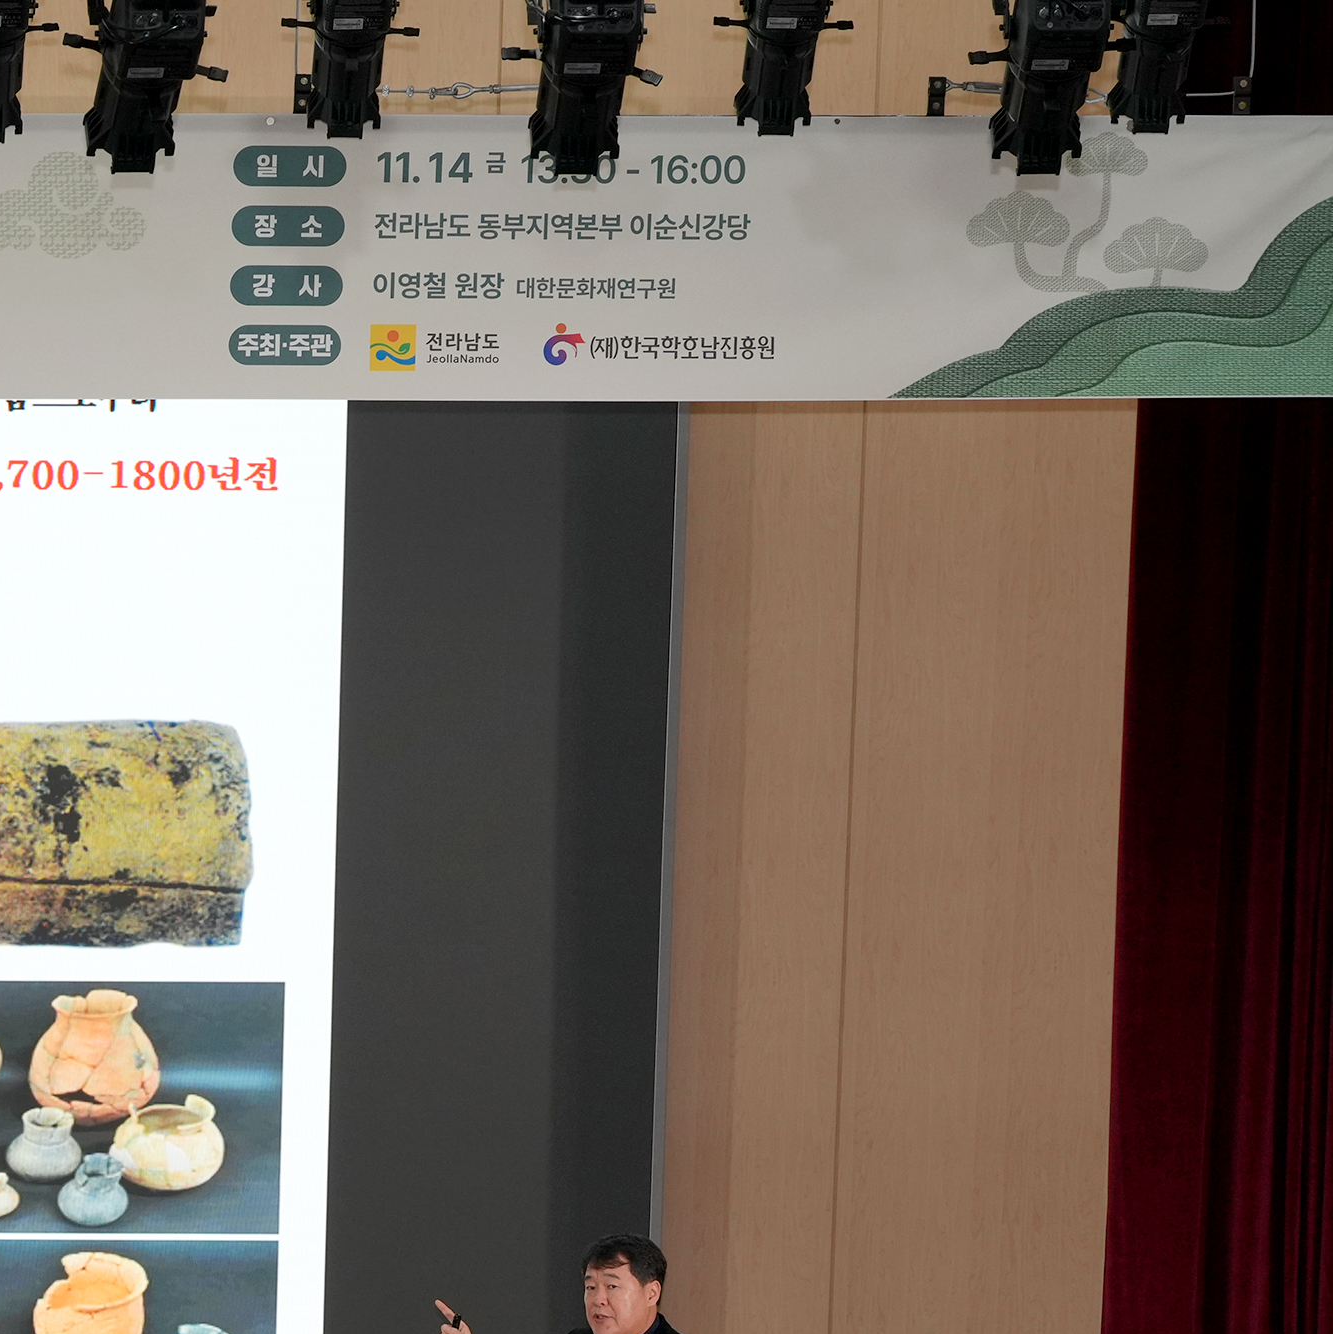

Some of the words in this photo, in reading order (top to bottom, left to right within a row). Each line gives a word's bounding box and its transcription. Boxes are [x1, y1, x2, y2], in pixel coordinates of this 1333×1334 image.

[257, 155, 277, 177] 일
[303, 155, 324, 178] 시
[486, 152, 506, 173] 금
[521, 153, 616, 184] 13:0
[651, 155, 745, 184] 16:00
[255, 215, 277, 237] 장
[301, 215, 322, 237] 소
[375, 213, 470, 239] 전라남도
[478, 213, 622, 240] 동부지역본부
[631, 214, 751, 240] 이순신강당
[253, 274, 275, 297] 강
[299, 275, 321, 297] 사
[374, 272, 445, 298] 이영철
[455, 273, 504, 299] 원장
[517, 278, 675, 299] 대한문화재연구원
[426, 333, 499, 351] 전라남도
[591, 336, 774, 359] (재)한국학호남진흥원
[427, 354, 499, 363] JeollaNamdo
